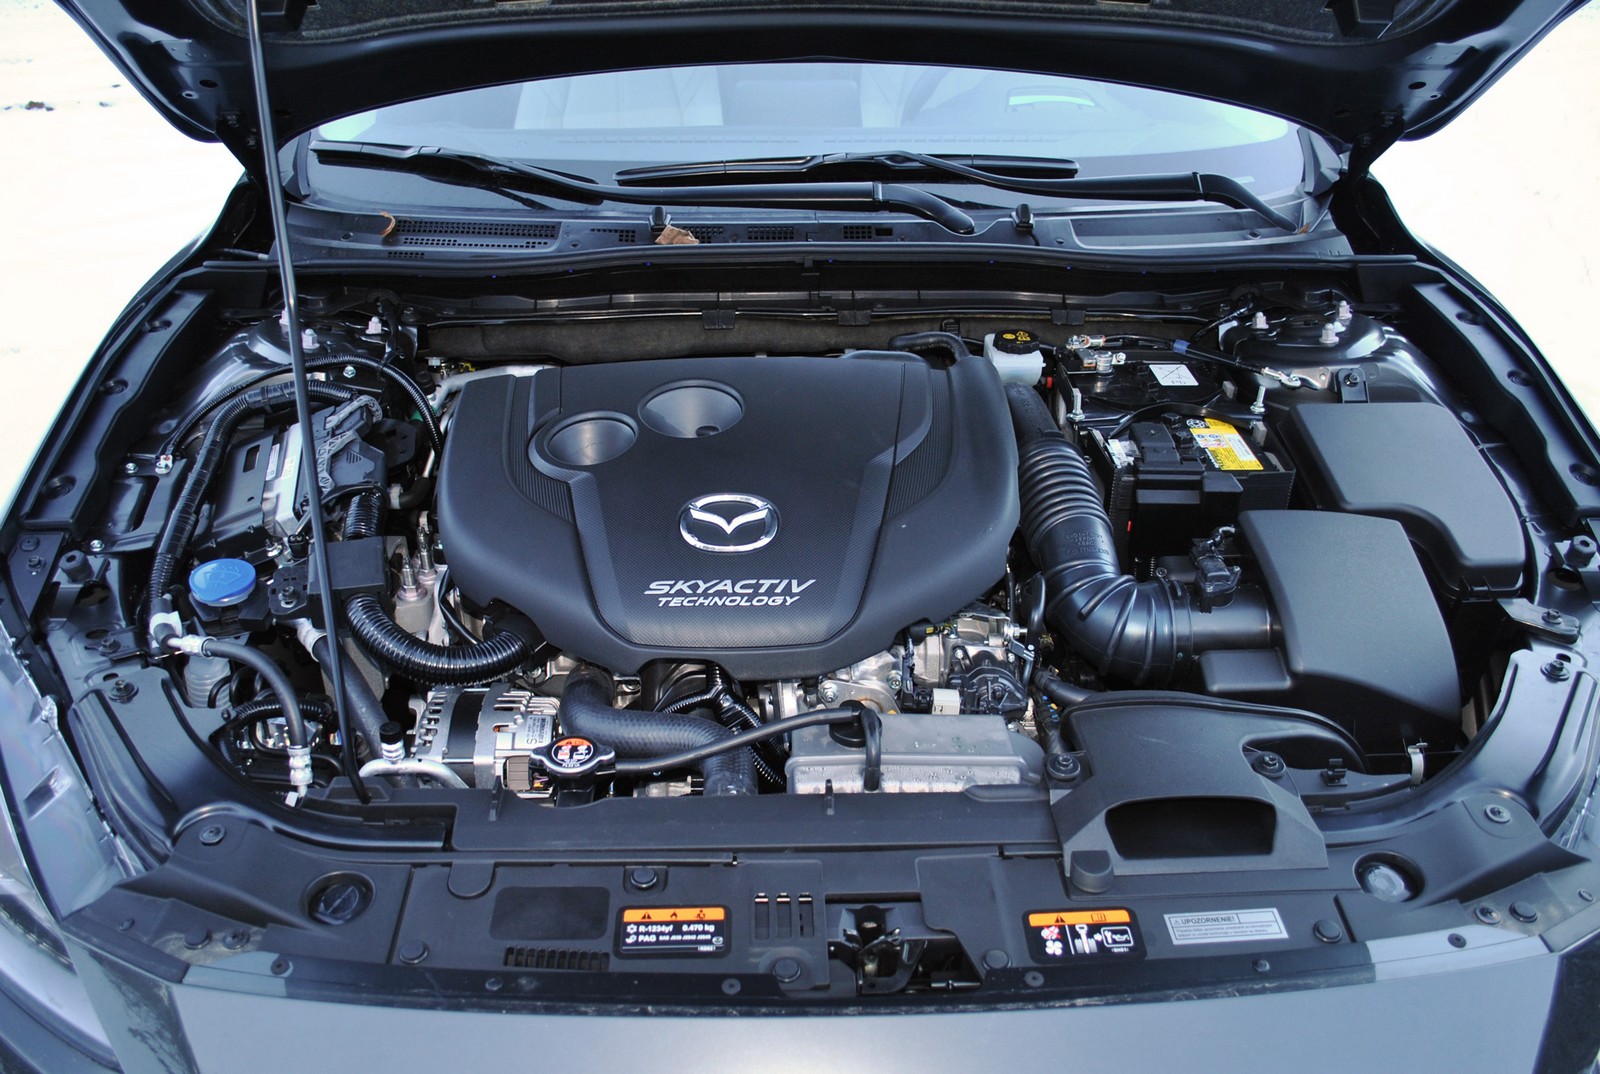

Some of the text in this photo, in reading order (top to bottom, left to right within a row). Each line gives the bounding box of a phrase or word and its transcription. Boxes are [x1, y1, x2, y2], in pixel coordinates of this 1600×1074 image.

[644, 579, 816, 594] SKYACTIV
[658, 596, 800, 607] TECHNOLOGY
[1181, 915, 1236, 925] UPOZORNENIE!
[638, 924, 715, 934] R-1234yf 0.470 kg
[638, 934, 657, 943] PAG
